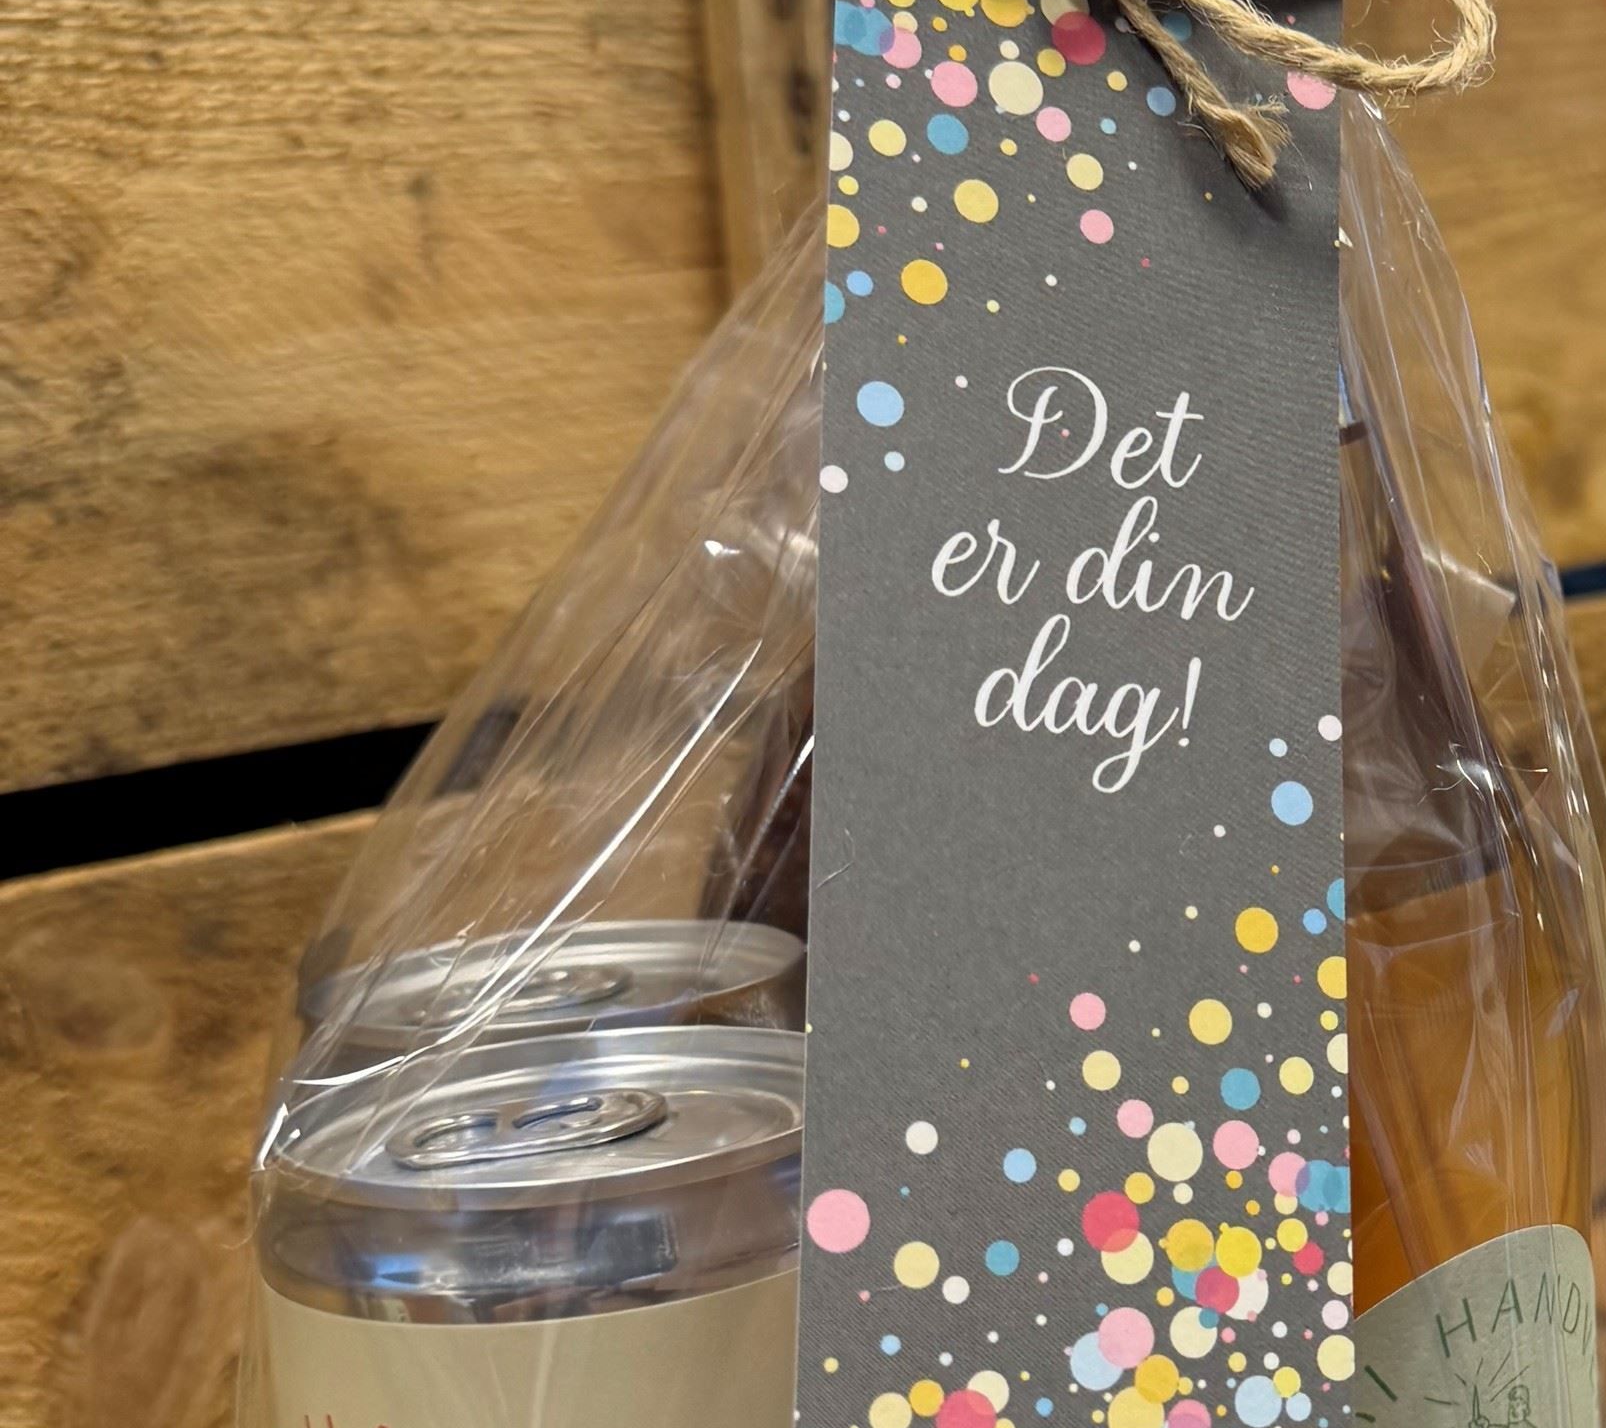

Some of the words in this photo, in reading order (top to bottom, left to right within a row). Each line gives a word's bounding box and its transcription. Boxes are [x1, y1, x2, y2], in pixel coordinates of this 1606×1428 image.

[999, 366, 1204, 489] Det
[931, 518, 1040, 605] er
[1066, 496, 1255, 621] din
[974, 614, 1202, 793] dag!
